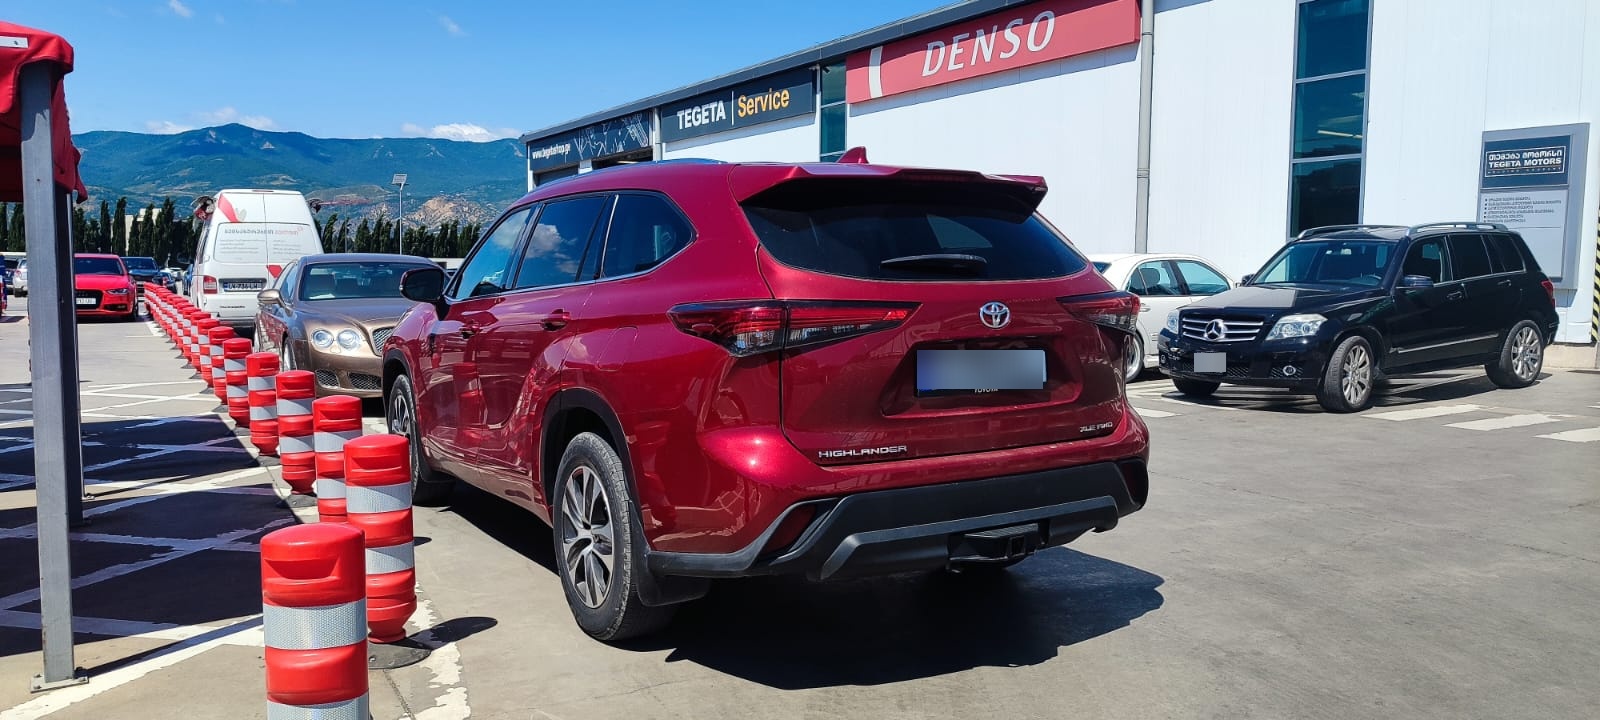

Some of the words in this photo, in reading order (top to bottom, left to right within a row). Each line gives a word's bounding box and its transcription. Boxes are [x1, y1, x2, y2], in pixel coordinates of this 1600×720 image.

[922, 10, 1056, 78] DENSO
[677, 100, 727, 130] TEGETA
[737, 87, 790, 118] Service
[1488, 160, 1521, 169] TEGETA
[1523, 157, 1562, 167] MOTORS
[818, 445, 908, 458] HIGHLANDER
